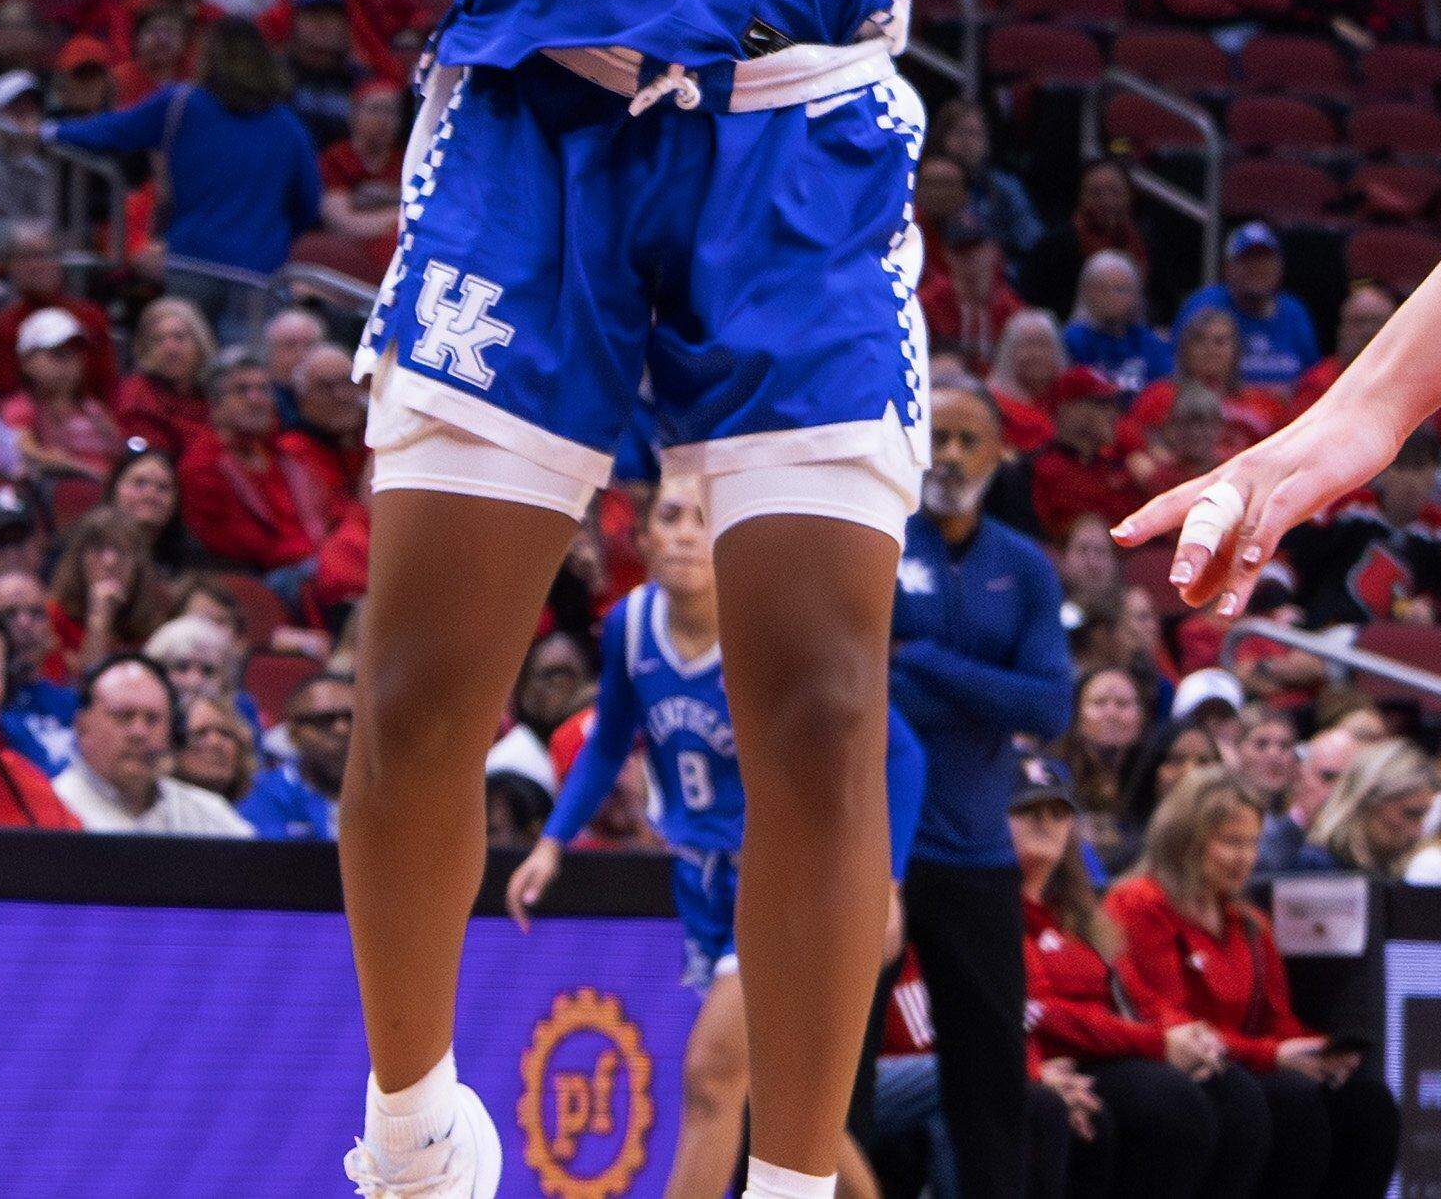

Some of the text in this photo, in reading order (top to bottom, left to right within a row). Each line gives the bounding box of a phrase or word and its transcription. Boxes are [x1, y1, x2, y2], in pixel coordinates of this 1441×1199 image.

[409, 258, 516, 392] UK
[676, 751, 716, 812] 8
[552, 1049, 620, 1161] pf
